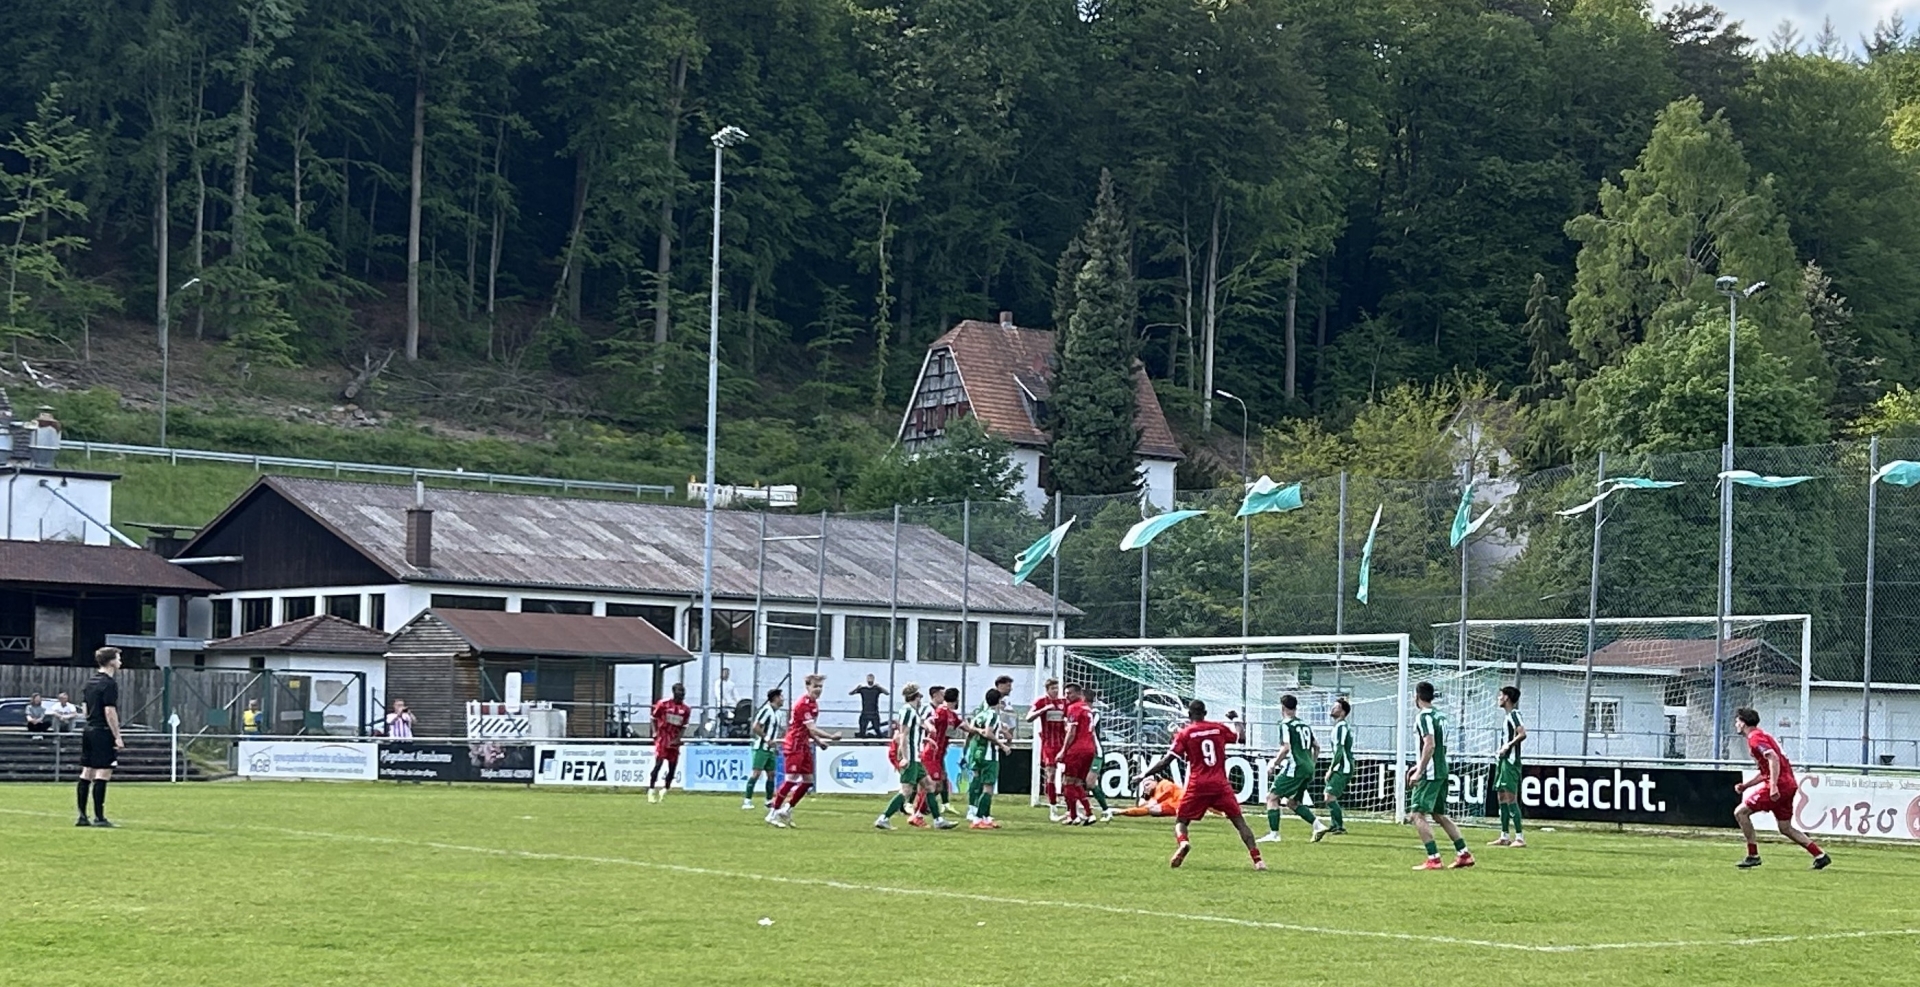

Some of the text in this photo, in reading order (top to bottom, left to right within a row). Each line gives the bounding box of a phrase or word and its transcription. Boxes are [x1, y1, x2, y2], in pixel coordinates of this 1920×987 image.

[1295, 727, 1311, 750] 19
[1201, 739, 1217, 767] 9
[560, 760, 607, 781] PETA
[695, 759, 749, 781] JOKEL
[1521, 767, 1666, 812] edacht.
[1795, 774, 1898, 835] Enzo
